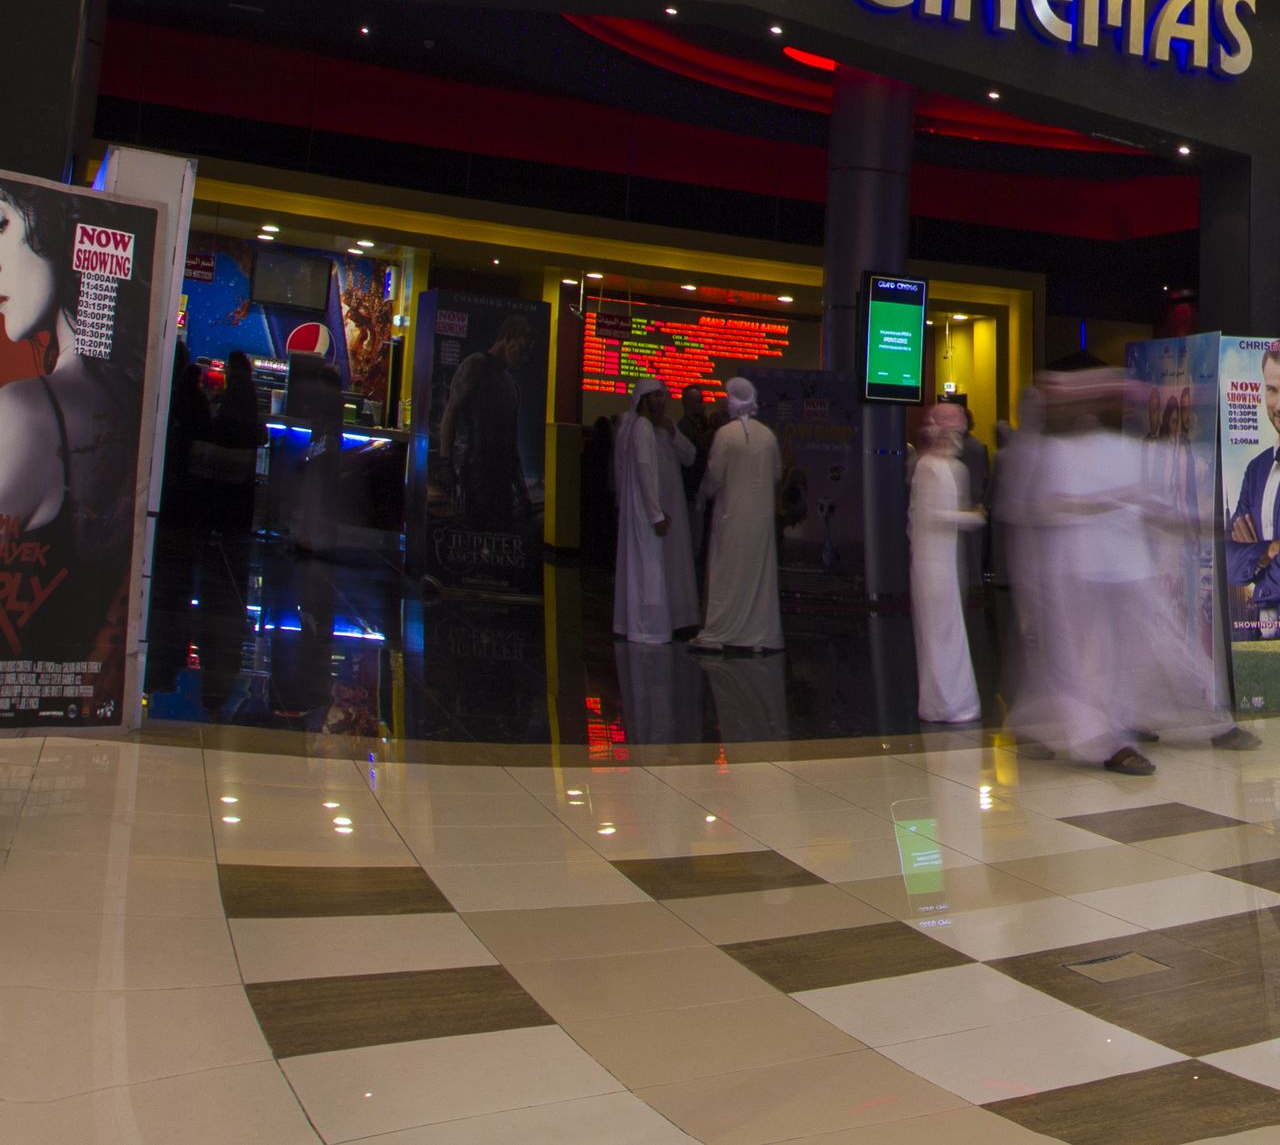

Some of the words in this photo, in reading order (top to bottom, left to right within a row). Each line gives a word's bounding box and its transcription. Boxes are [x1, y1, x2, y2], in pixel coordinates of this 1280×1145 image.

[79, 225, 133, 253] NOW
[75, 248, 131, 278] SHOWING
[81, 271, 120, 284] 10:00AM
[80, 280, 119, 293] 11:45AM
[79, 290, 117, 303] 01:30PM
[78, 299, 116, 312] 03:15PM
[78, 309, 115, 321] 05:00PM
[77, 318, 114, 331] 06:45PM
[76, 327, 113, 341] 08:30PM
[75, 337, 112, 350] 10:20PM
[1230, 381, 1261, 393] NOW
[1226, 392, 1262, 404] SHOWING
[1233, 621, 1273, 629] SHOWING
